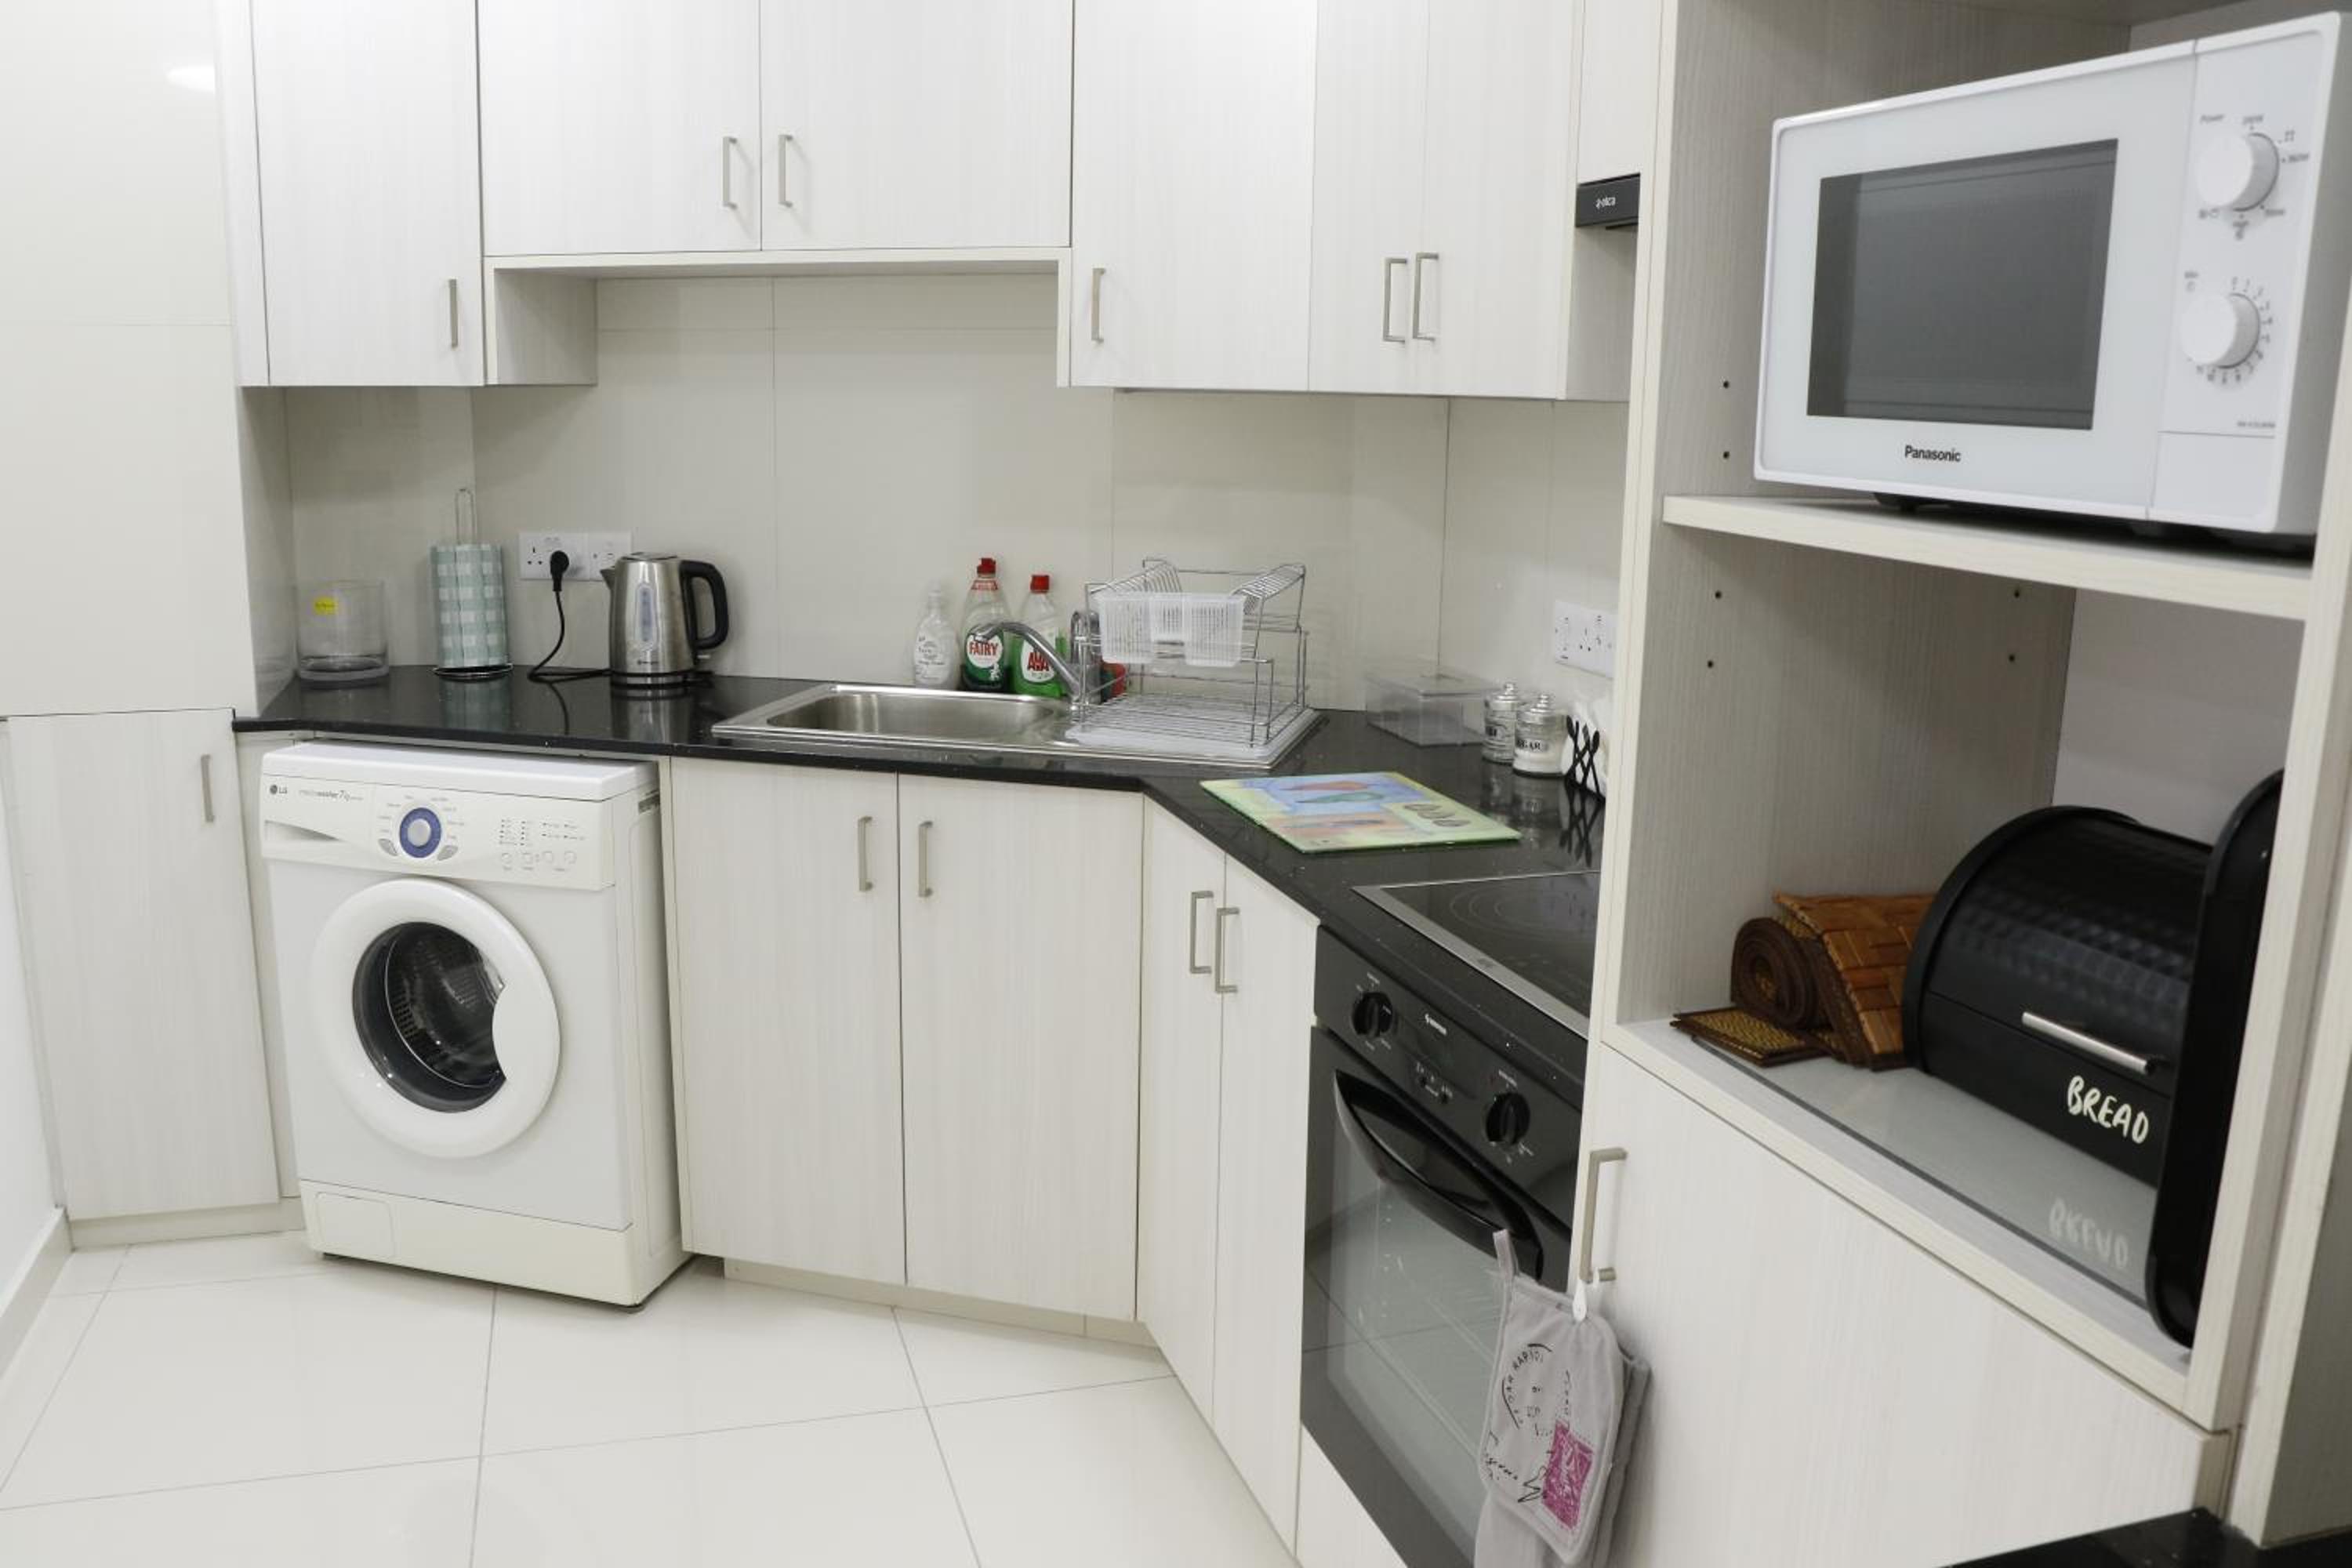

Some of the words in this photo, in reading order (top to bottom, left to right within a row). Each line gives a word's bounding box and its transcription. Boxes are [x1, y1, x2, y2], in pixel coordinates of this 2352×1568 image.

[1904, 444, 1962, 462] Panasonic
[969, 641, 998, 656] FAIRY
[2067, 1075, 2149, 1145] BREAD
